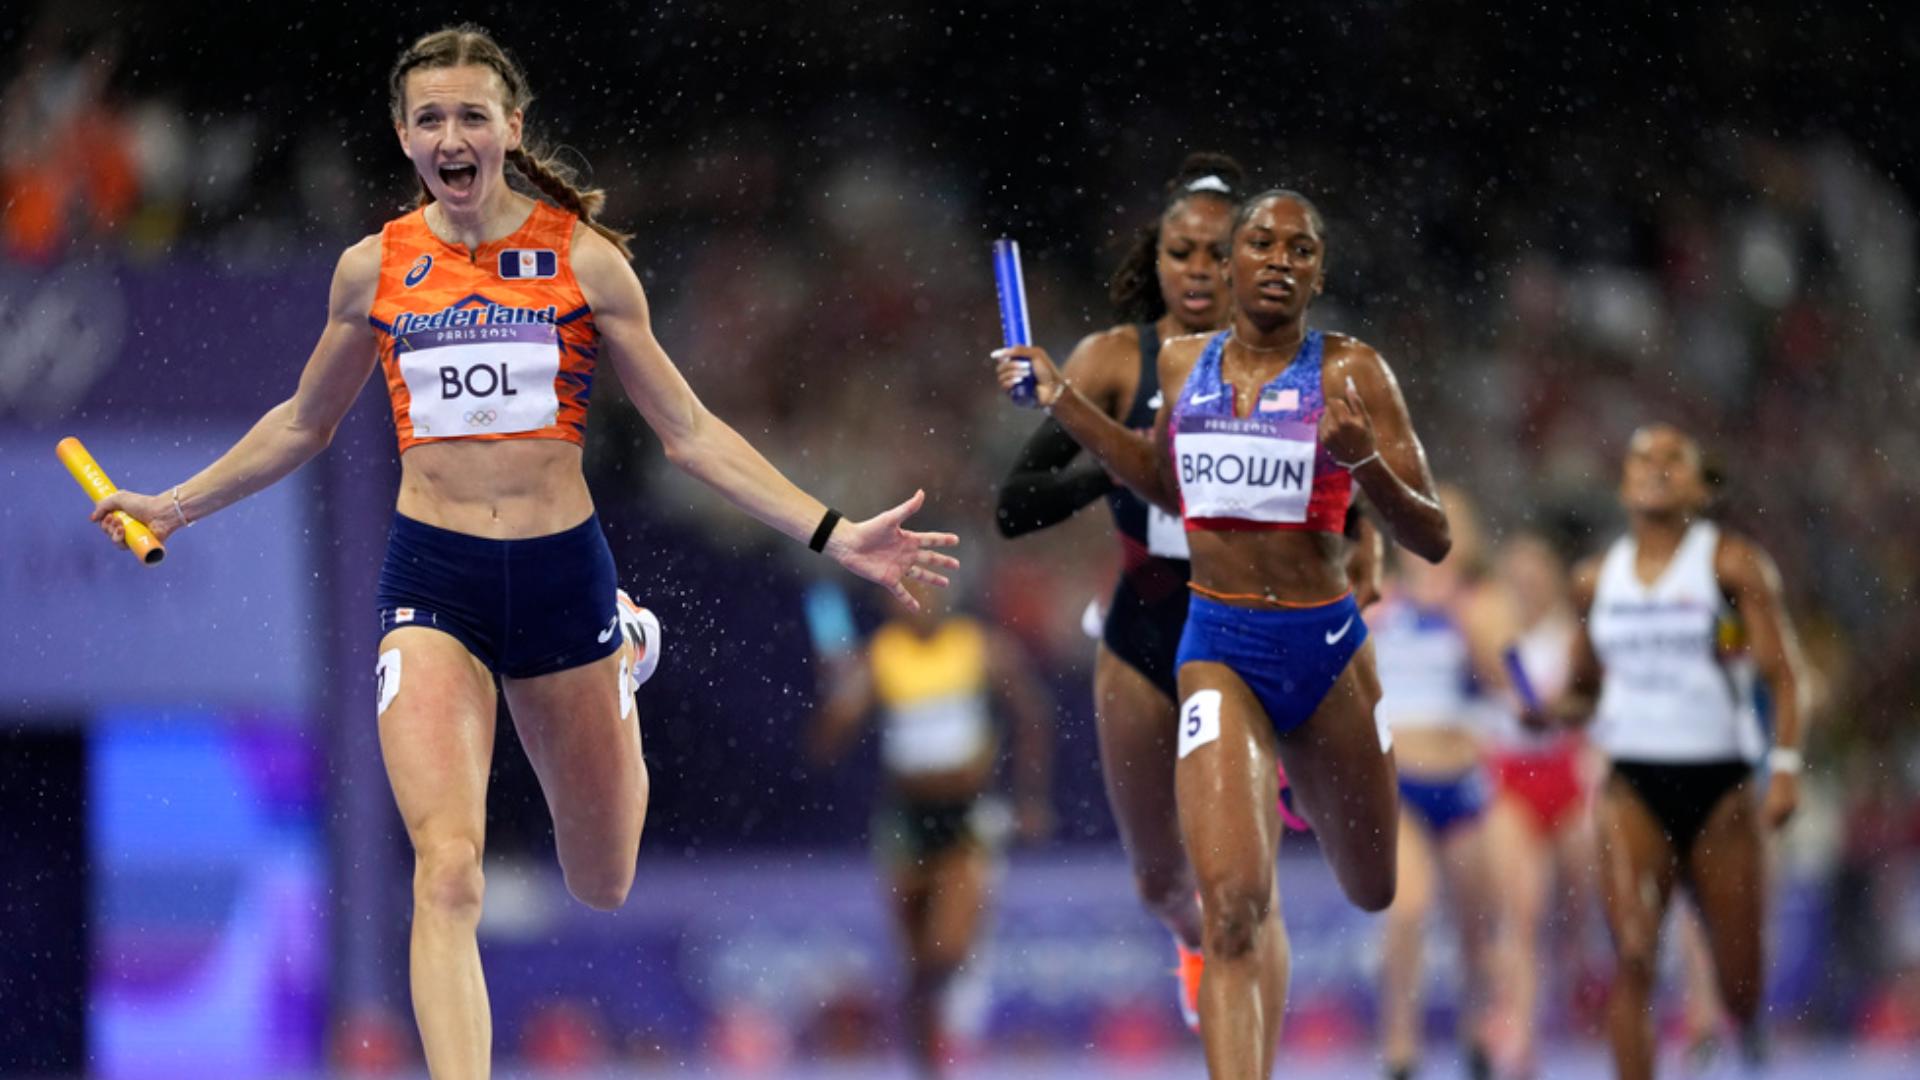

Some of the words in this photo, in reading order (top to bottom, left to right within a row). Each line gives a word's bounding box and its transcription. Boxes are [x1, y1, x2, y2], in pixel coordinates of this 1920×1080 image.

[437, 329, 476, 342] PARIS
[480, 327, 517, 339] 2024
[439, 363, 517, 400] BOL
[1181, 453, 1305, 490] BROWN
[1187, 704, 1202, 738] 5
